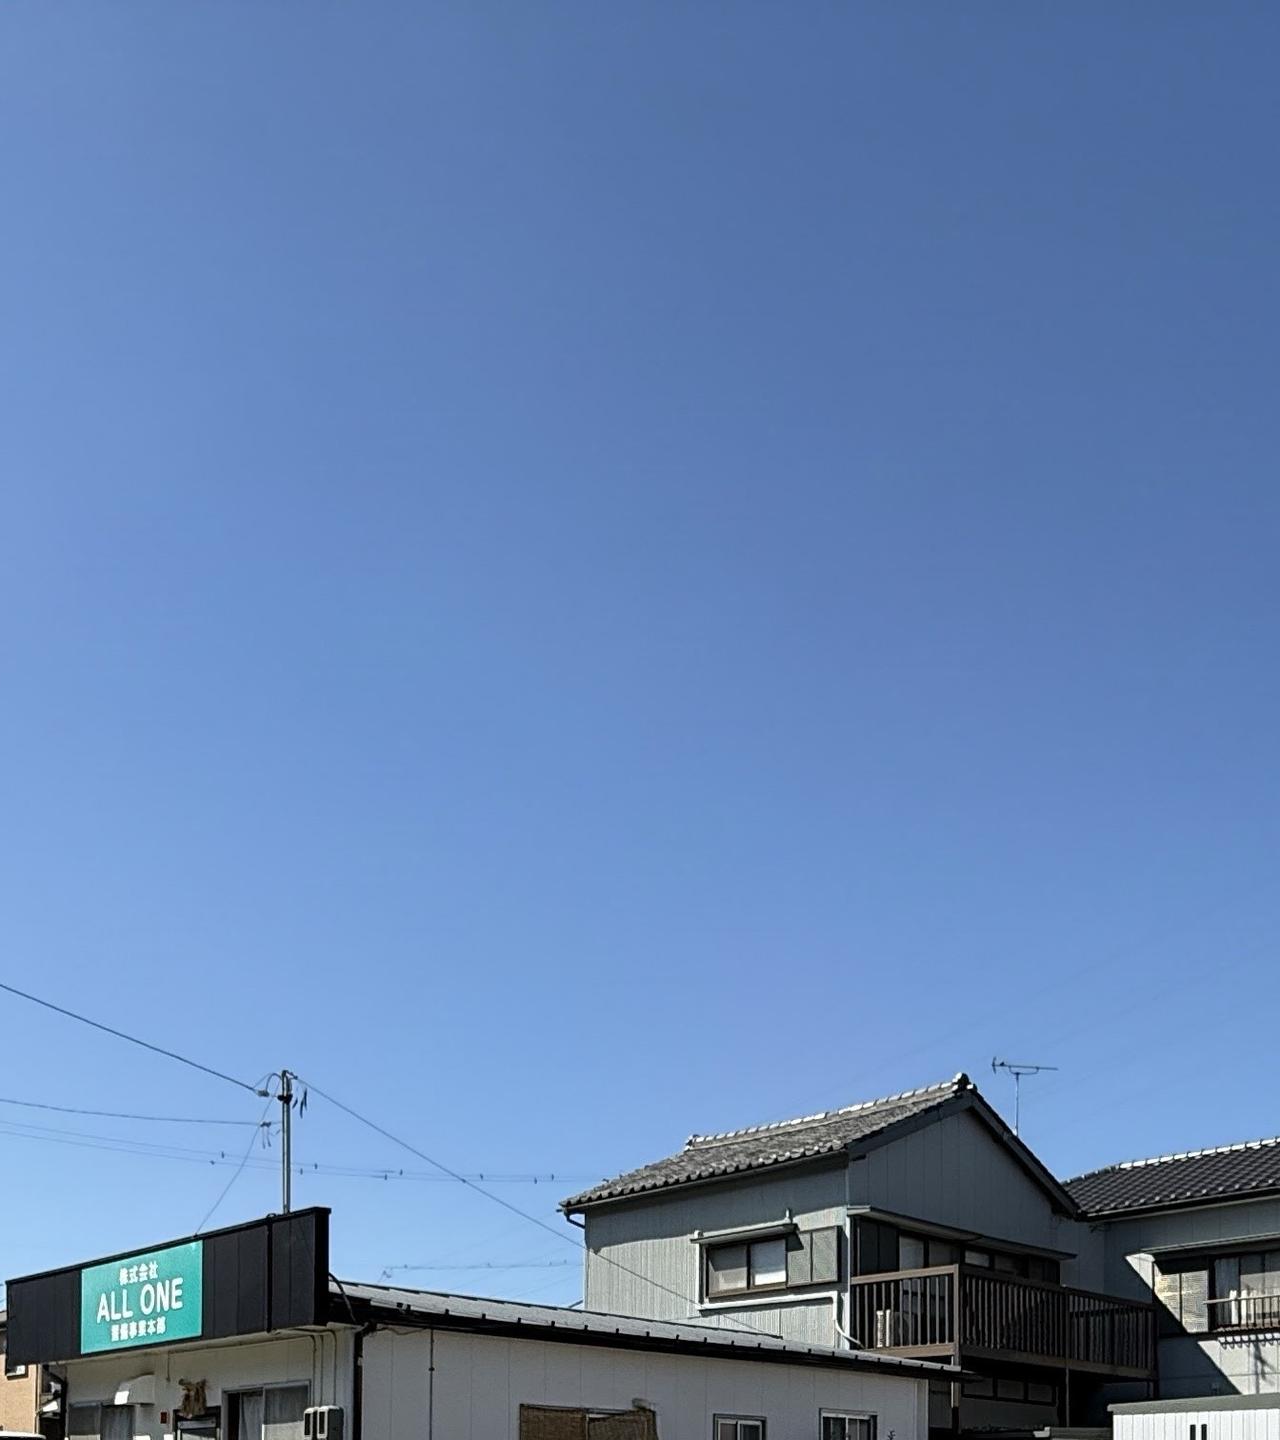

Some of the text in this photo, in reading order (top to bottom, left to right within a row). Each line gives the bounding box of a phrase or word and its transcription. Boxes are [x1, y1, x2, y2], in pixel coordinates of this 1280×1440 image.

[120, 1261, 158, 1285] 株式会社
[97, 1277, 184, 1323] ALL ONE
